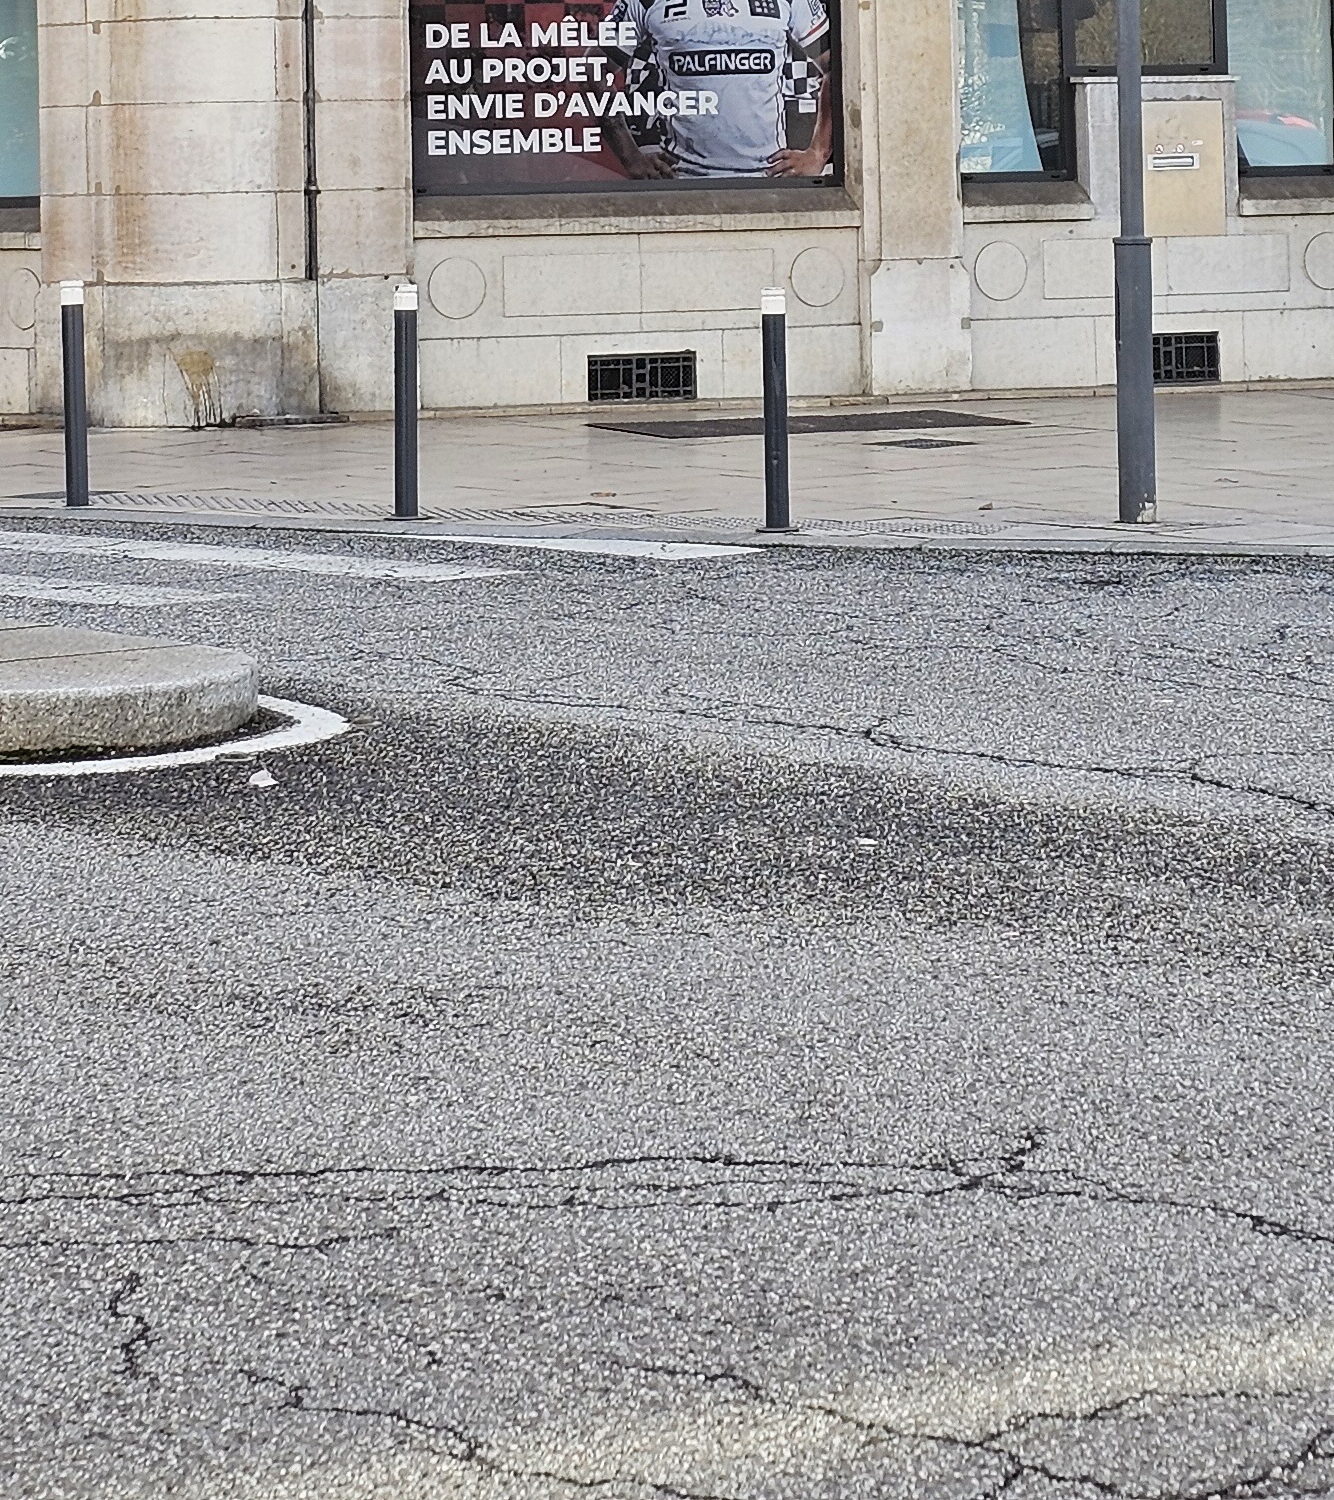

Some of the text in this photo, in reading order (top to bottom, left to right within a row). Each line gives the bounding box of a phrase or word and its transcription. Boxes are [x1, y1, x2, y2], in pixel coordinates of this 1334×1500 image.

[425, 14, 638, 49] DE LA MÊLÉE
[424, 56, 615, 87] AU PROJET,
[673, 52, 773, 73] PALFINGER
[427, 90, 719, 120] ENVIE D'AVANCER
[427, 126, 603, 156] ENSEMBLE
